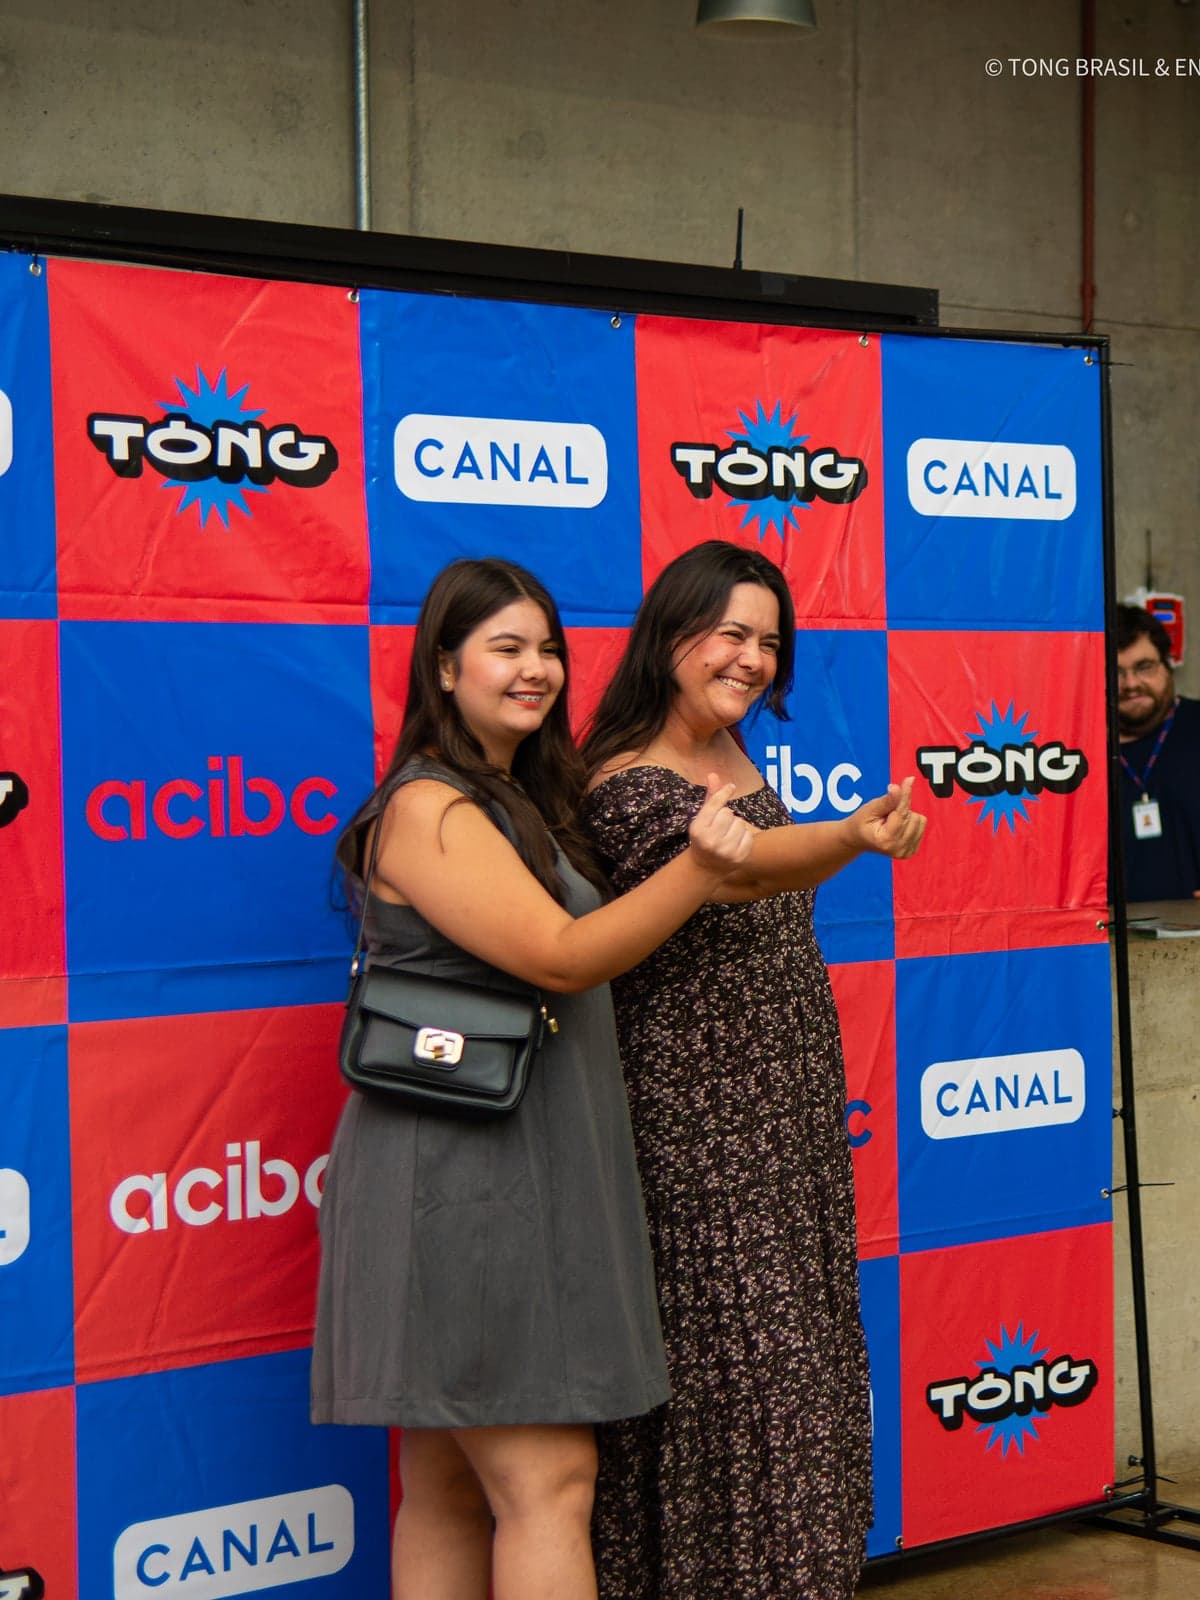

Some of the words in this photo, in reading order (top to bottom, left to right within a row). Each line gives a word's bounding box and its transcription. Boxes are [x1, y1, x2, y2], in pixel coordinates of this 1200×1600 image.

[413, 437, 591, 487] CANAL
[922, 459, 1065, 501] CANAL
[86, 756, 339, 841] acibc
[765, 745, 863, 814] ibc
[935, 1070, 1073, 1118] CANAL
[135, 1512, 335, 1588] CANAL
